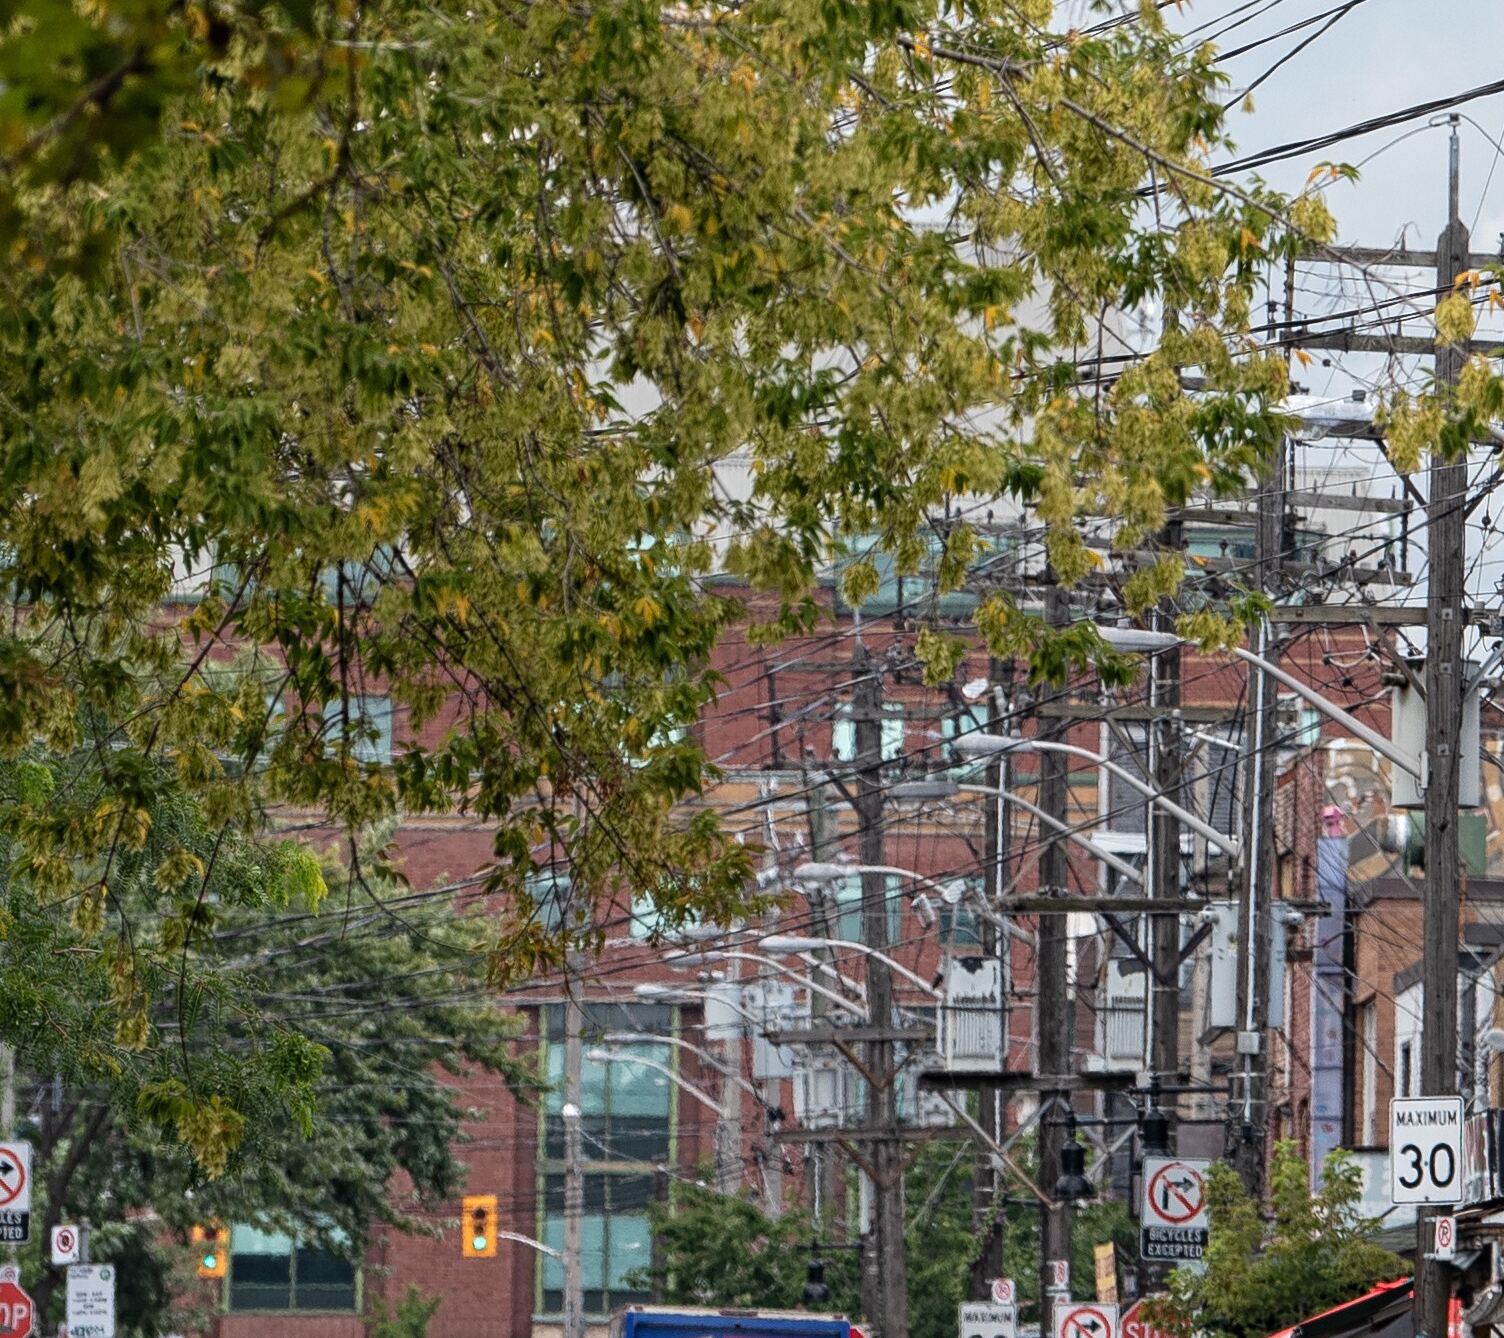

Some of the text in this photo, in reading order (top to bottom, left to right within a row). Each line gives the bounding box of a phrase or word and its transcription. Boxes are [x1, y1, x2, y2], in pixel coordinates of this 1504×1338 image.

[1396, 1110, 1458, 1126] MAXIMUM
[1399, 1142, 1455, 1189] 30
[1149, 1230, 1202, 1243] BICYCLES
[1148, 1243, 1203, 1257] EXCEPTED
[964, 1312, 1012, 1323] MAXIMUM
